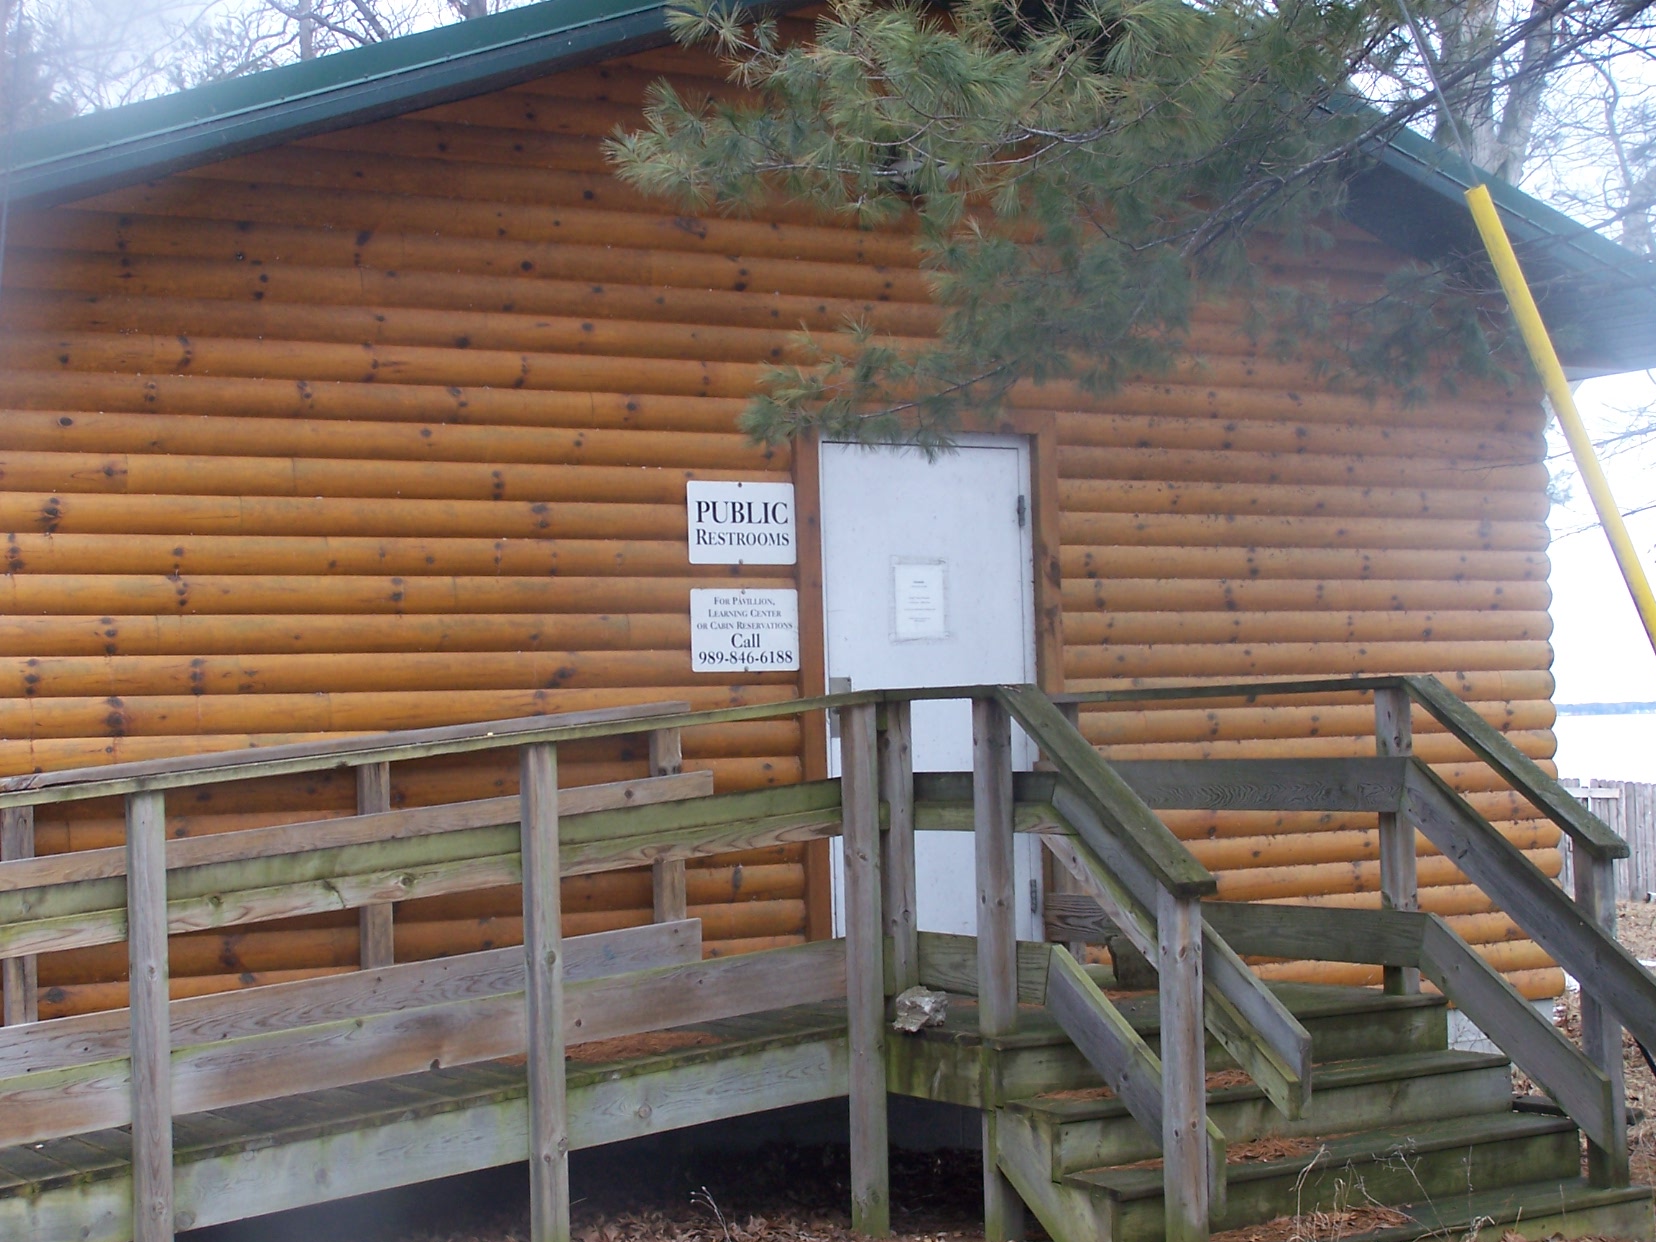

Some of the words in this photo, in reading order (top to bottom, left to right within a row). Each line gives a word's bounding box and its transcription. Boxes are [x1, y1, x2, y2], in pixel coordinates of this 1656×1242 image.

[695, 500, 789, 525] PUBLIC
[696, 528, 790, 547] RESTROOMS
[714, 596, 731, 606] FOR
[708, 609, 748, 618] LEARNING
[750, 609, 782, 618] CENTER
[710, 621, 734, 630] CABIN
[736, 621, 793, 630] RESERVATIONS
[731, 633, 761, 649] Call
[698, 650, 793, 665] 989-846-6188
